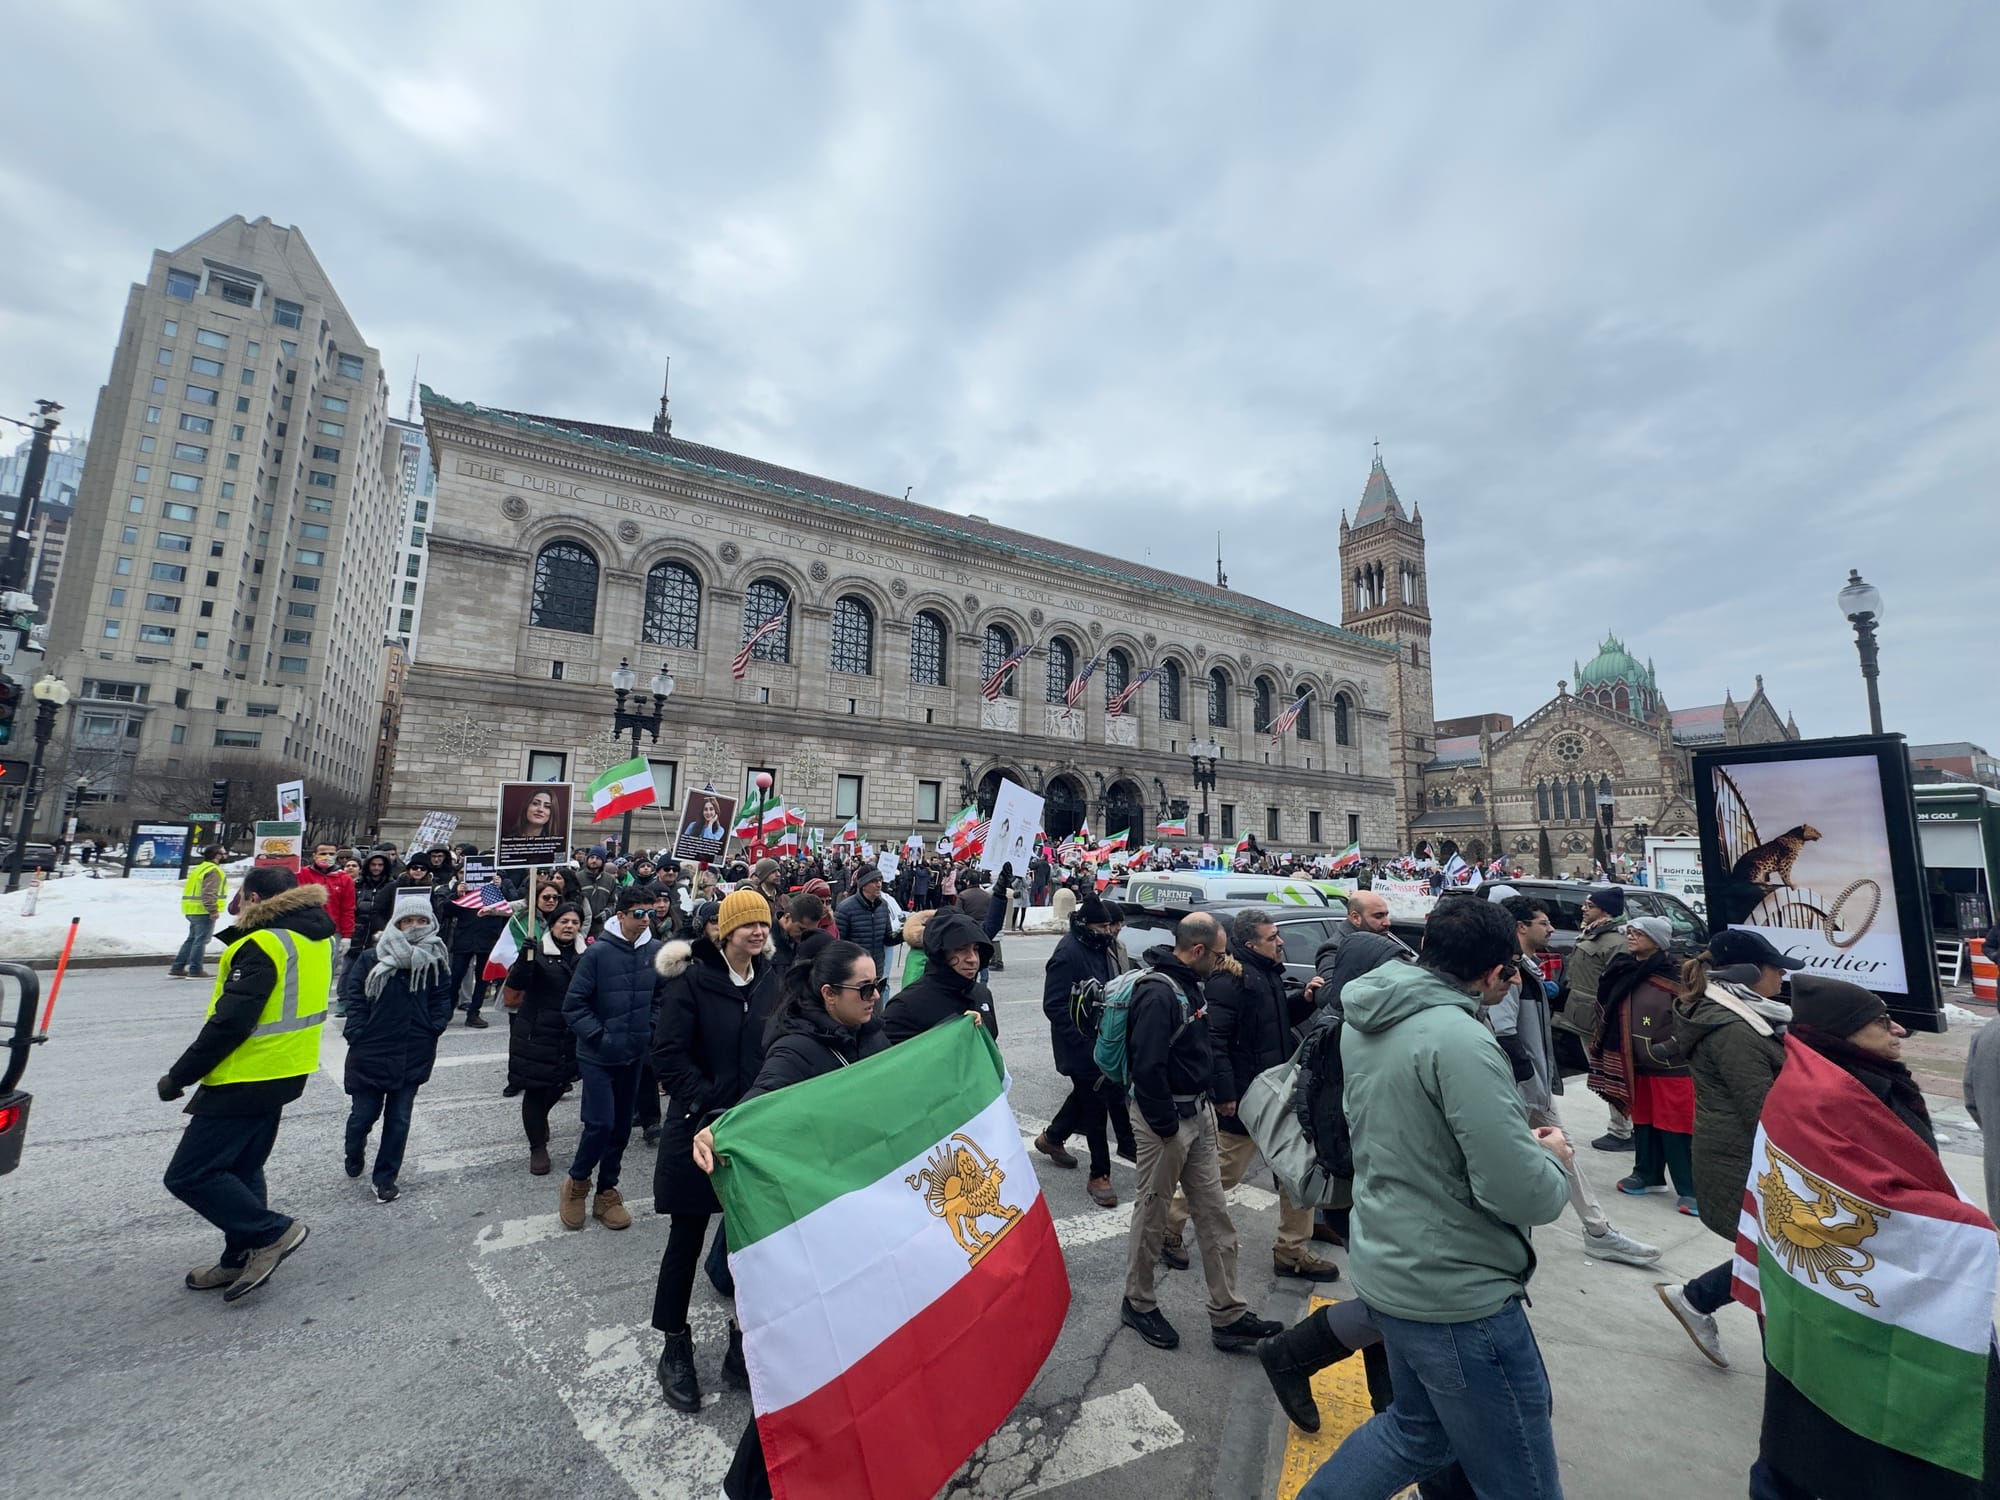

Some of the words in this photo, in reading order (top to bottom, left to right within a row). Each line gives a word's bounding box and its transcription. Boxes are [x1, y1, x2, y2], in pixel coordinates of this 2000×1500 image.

[465, 462, 504, 483] THE
[522, 474, 586, 500] PUBLIC
[603, 493, 680, 521] LIBRARY
[691, 513, 714, 527] OF
[728, 521, 758, 538] THE
[769, 531, 806, 547] CITY
[817, 542, 837, 556] OF
[846, 549, 904, 571] BOSTON
[912, 562, 947, 581] BUILT
[956, 573, 973, 585] BY
[981, 579, 1005, 593] THE
[1014, 587, 1054, 603] PEOPLE
[1063, 600, 1086, 613] AND
[1092, 604, 1148, 626] DEDICATED
[1156, 619, 1167, 630] TO
[1172, 623, 1190, 635] THE
[1196, 629, 1253, 649] ADVANCEMENT
[1930, 812, 1958, 820] GOLF
[1157, 888, 1193, 901] PARTNER
[1783, 944, 1887, 973] Cartier
